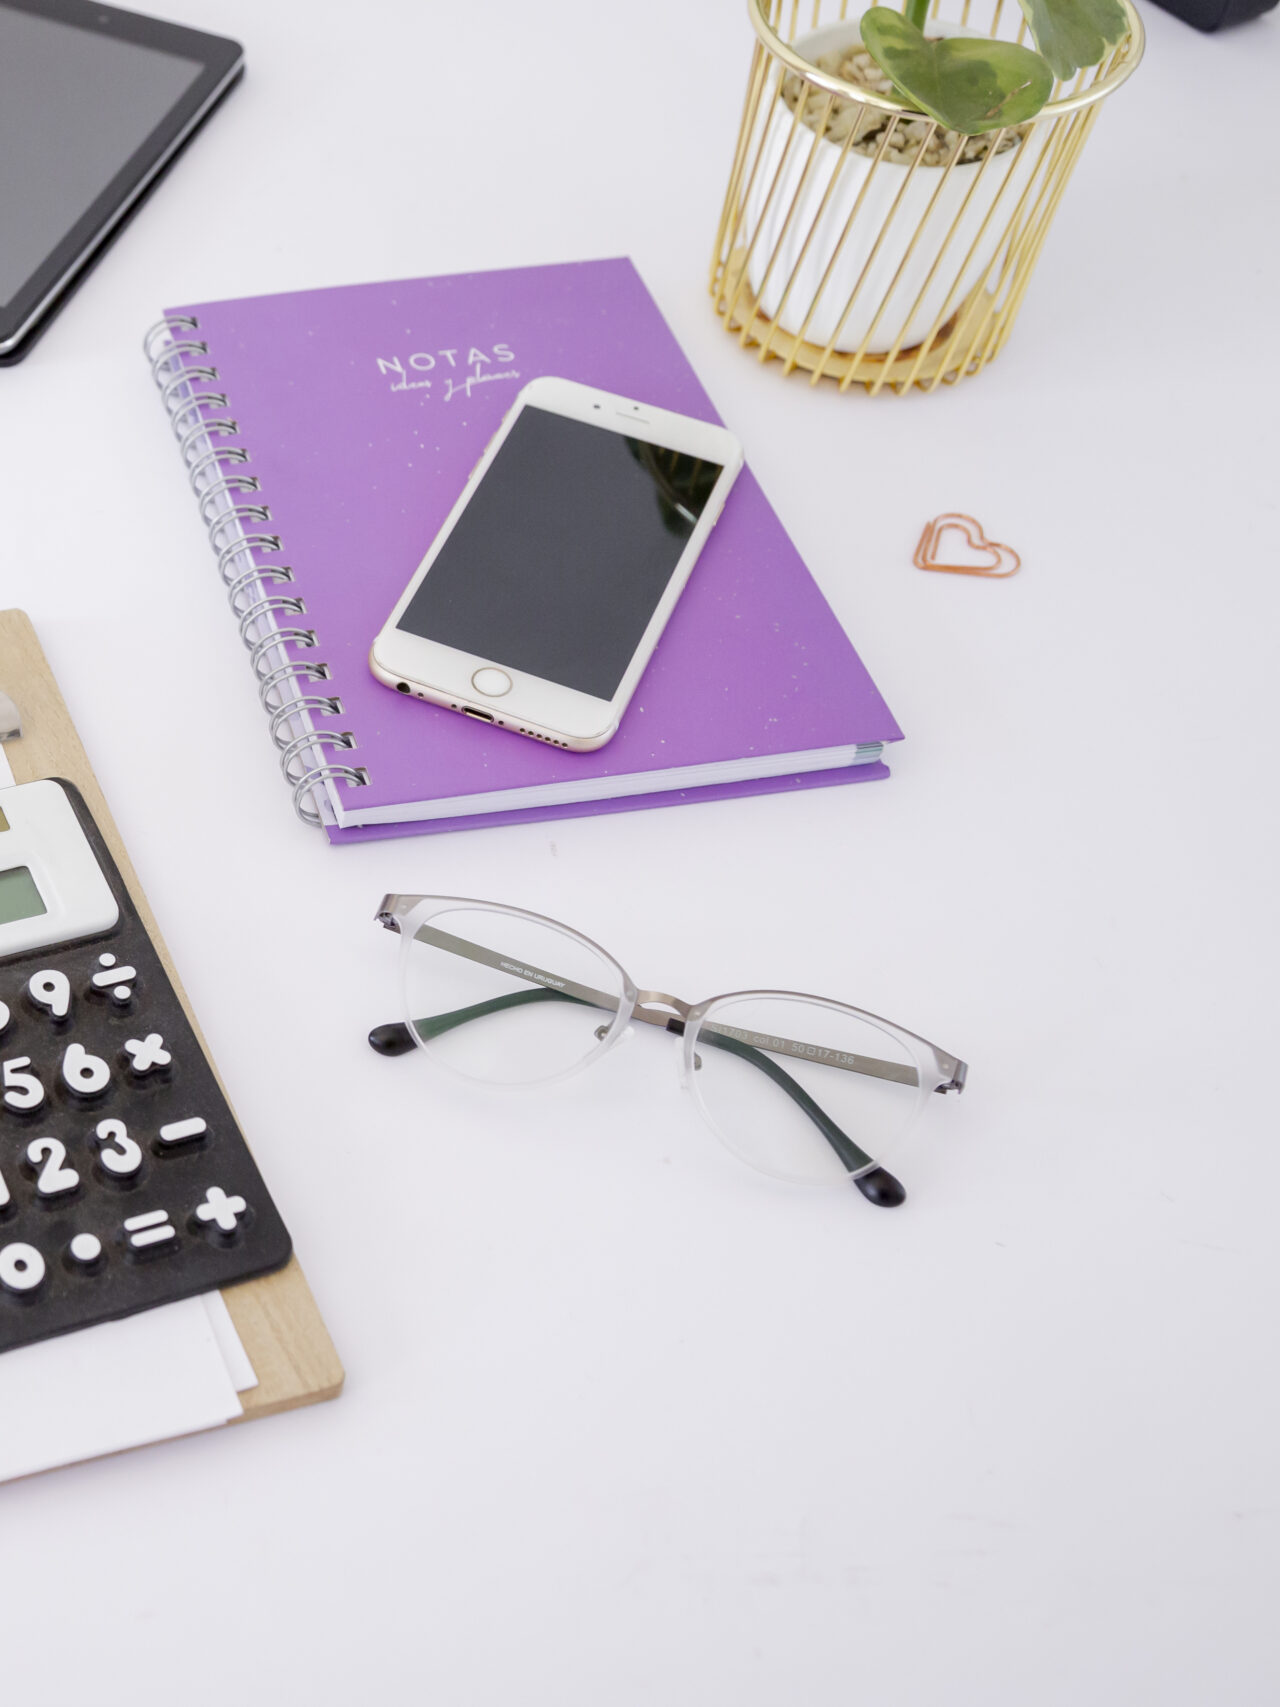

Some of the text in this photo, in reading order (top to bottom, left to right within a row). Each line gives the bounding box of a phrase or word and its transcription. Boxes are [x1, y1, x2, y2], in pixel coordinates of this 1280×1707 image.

[376, 343, 516, 375] NOTAS
[29, 969, 70, 1017] 9
[3, 1056, 45, 1109] 5
[62, 1043, 111, 1093] 6
[27, 1137, 80, 1194] 2
[96, 1118, 142, 1173] 3
